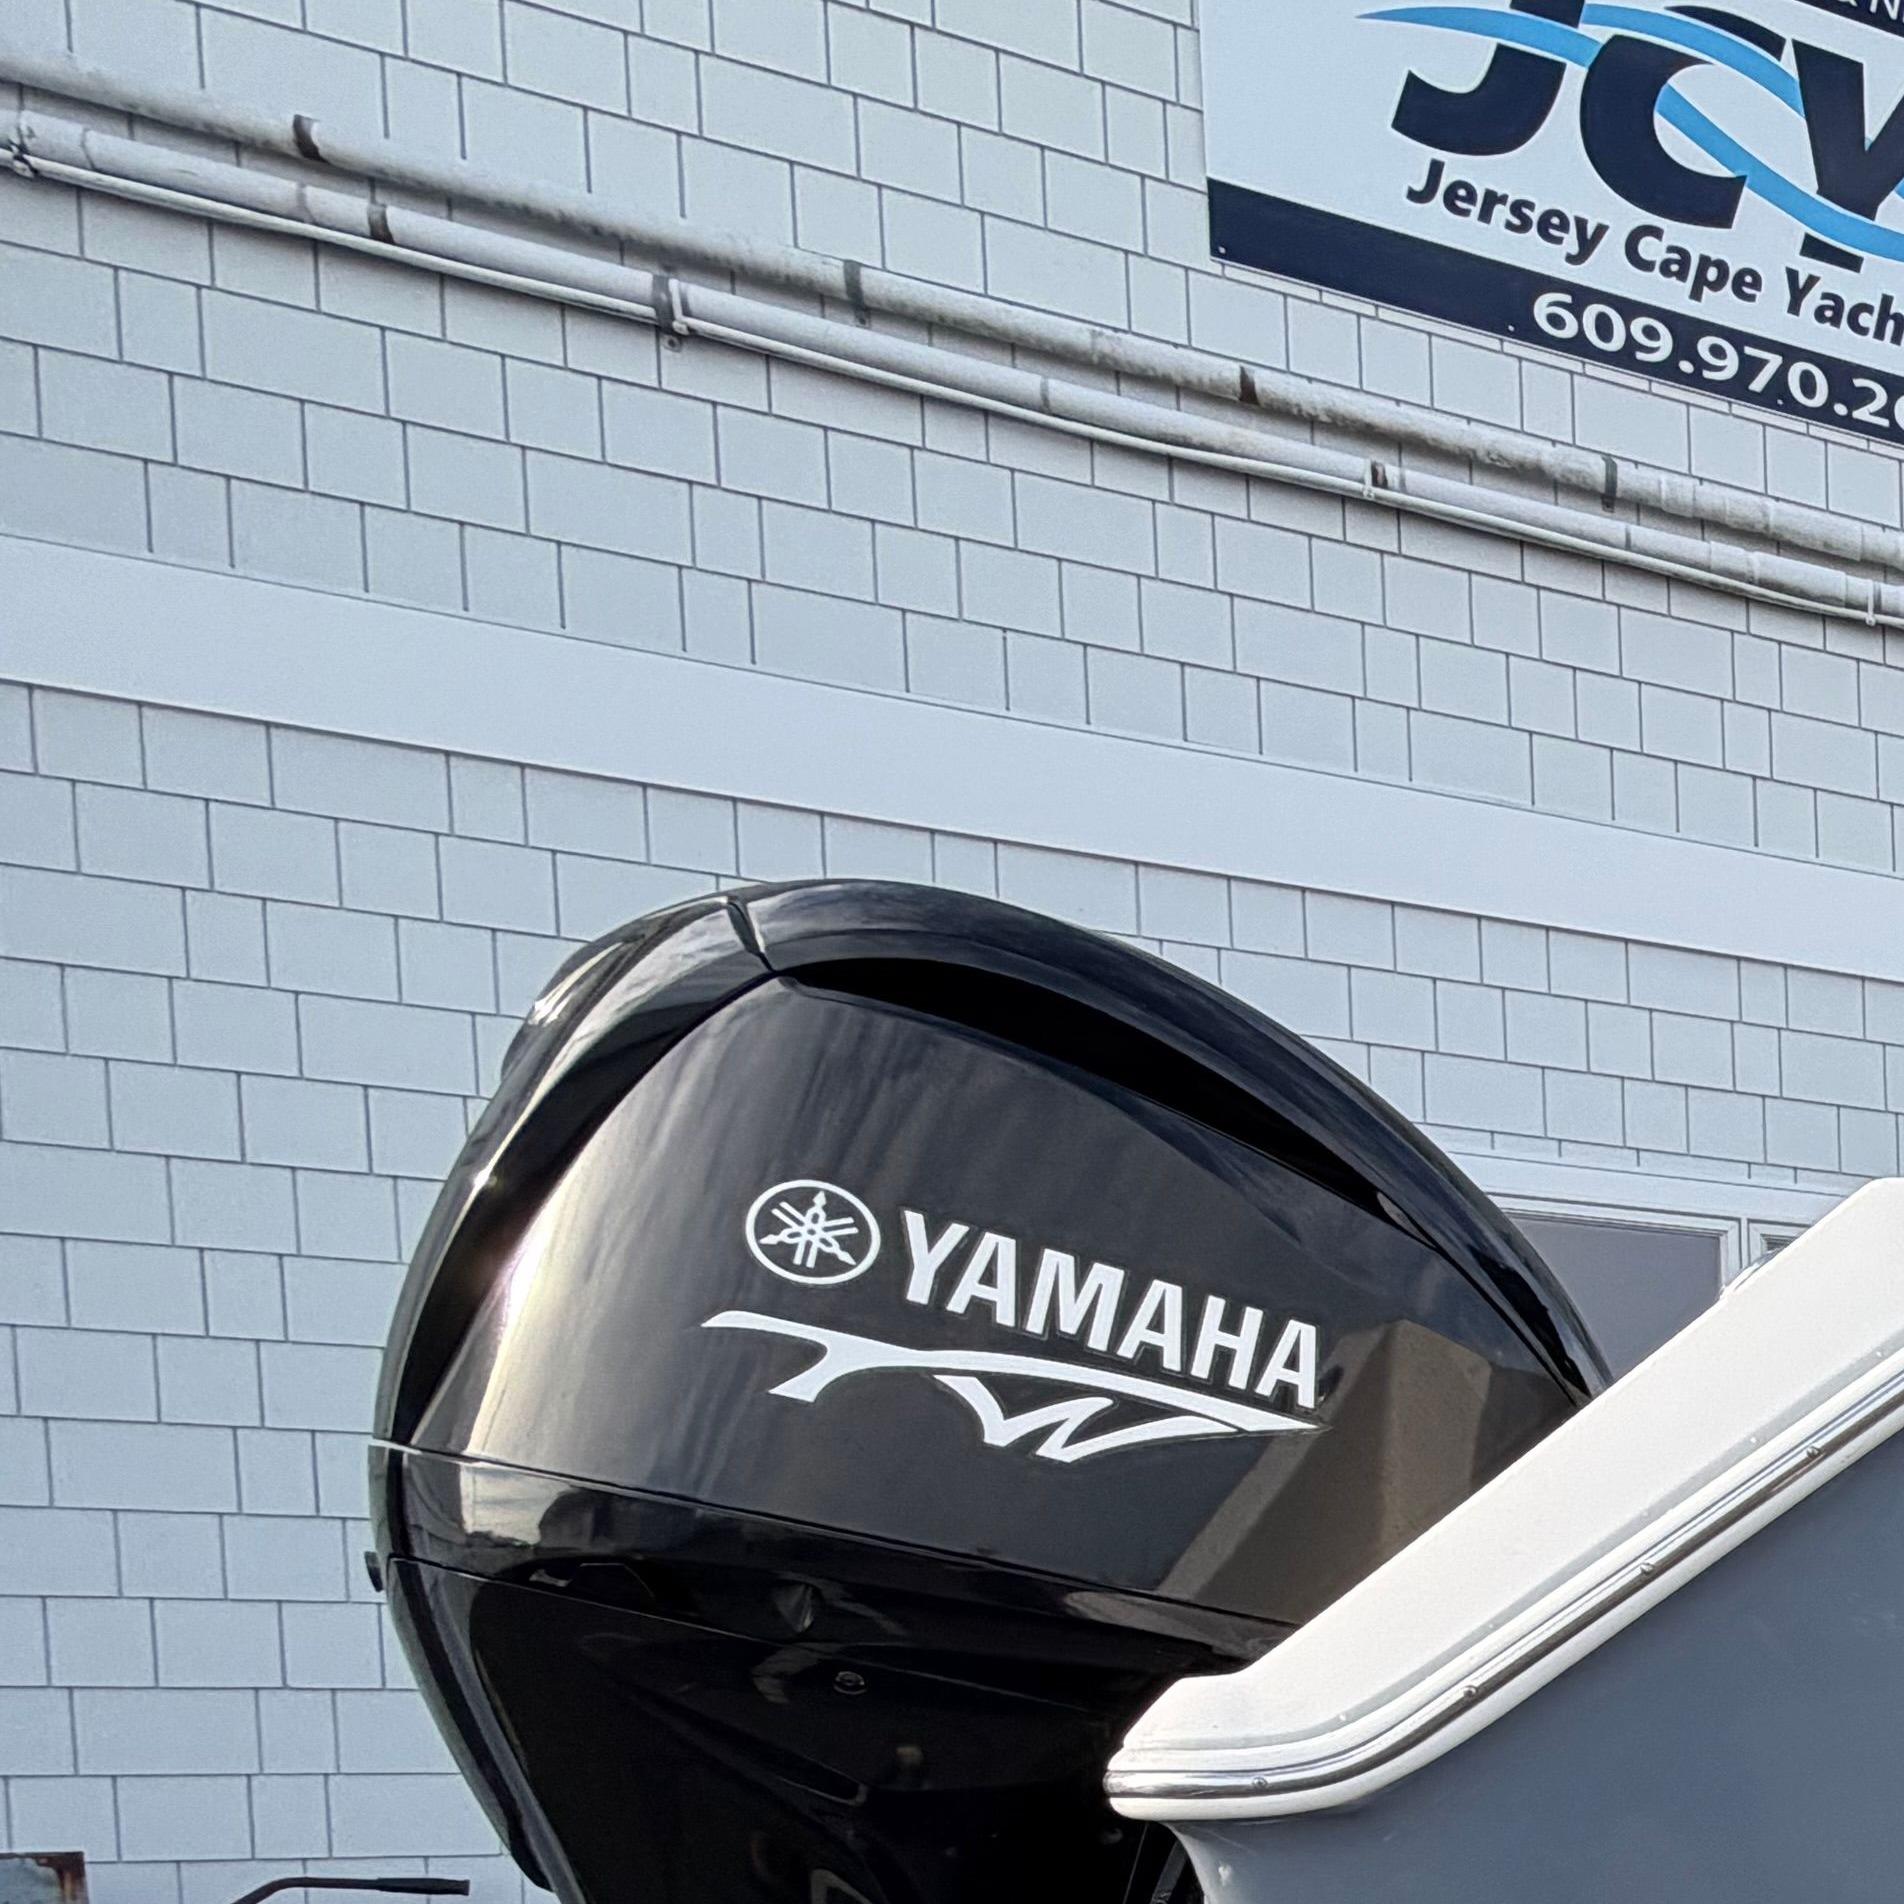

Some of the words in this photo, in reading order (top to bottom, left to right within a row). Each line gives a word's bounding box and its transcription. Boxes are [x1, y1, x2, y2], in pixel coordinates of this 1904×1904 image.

[1405, 158, 1611, 267] Jersey
[1623, 226, 1764, 305] Cape
[900, 1208, 1321, 1410] YAMAHA
